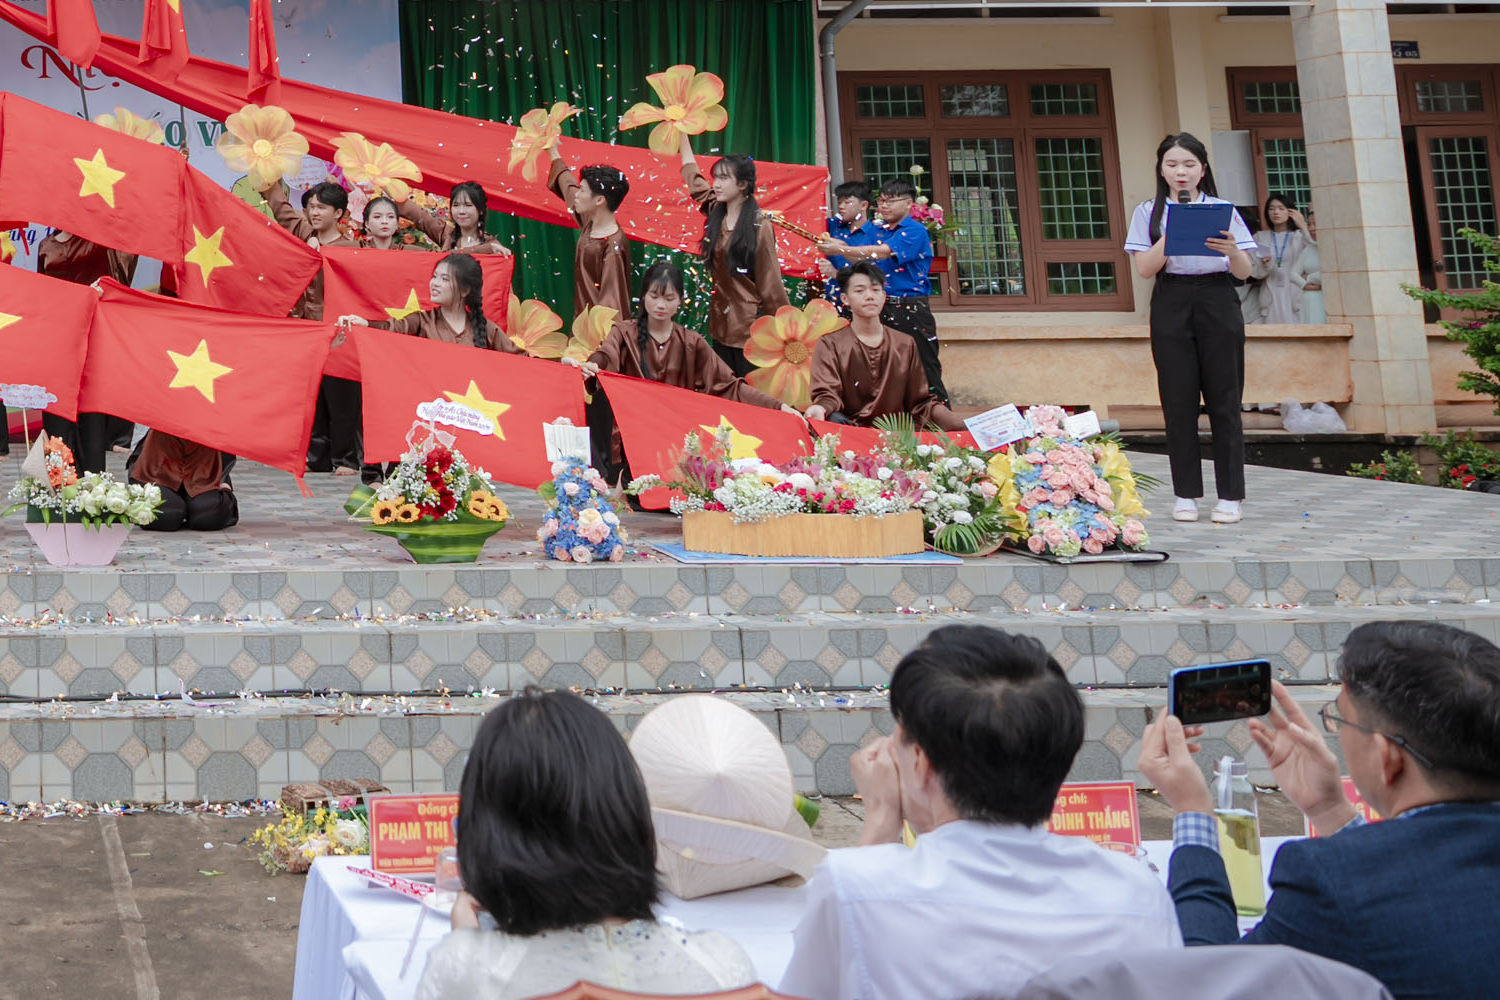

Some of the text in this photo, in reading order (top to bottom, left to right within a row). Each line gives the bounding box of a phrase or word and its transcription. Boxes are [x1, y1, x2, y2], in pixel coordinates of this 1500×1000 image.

[418, 803, 447, 817] Đồng
[1052, 805, 1131, 831] ĐÌNH THẮNG
[379, 821, 448, 845] PHẠM THỊ
